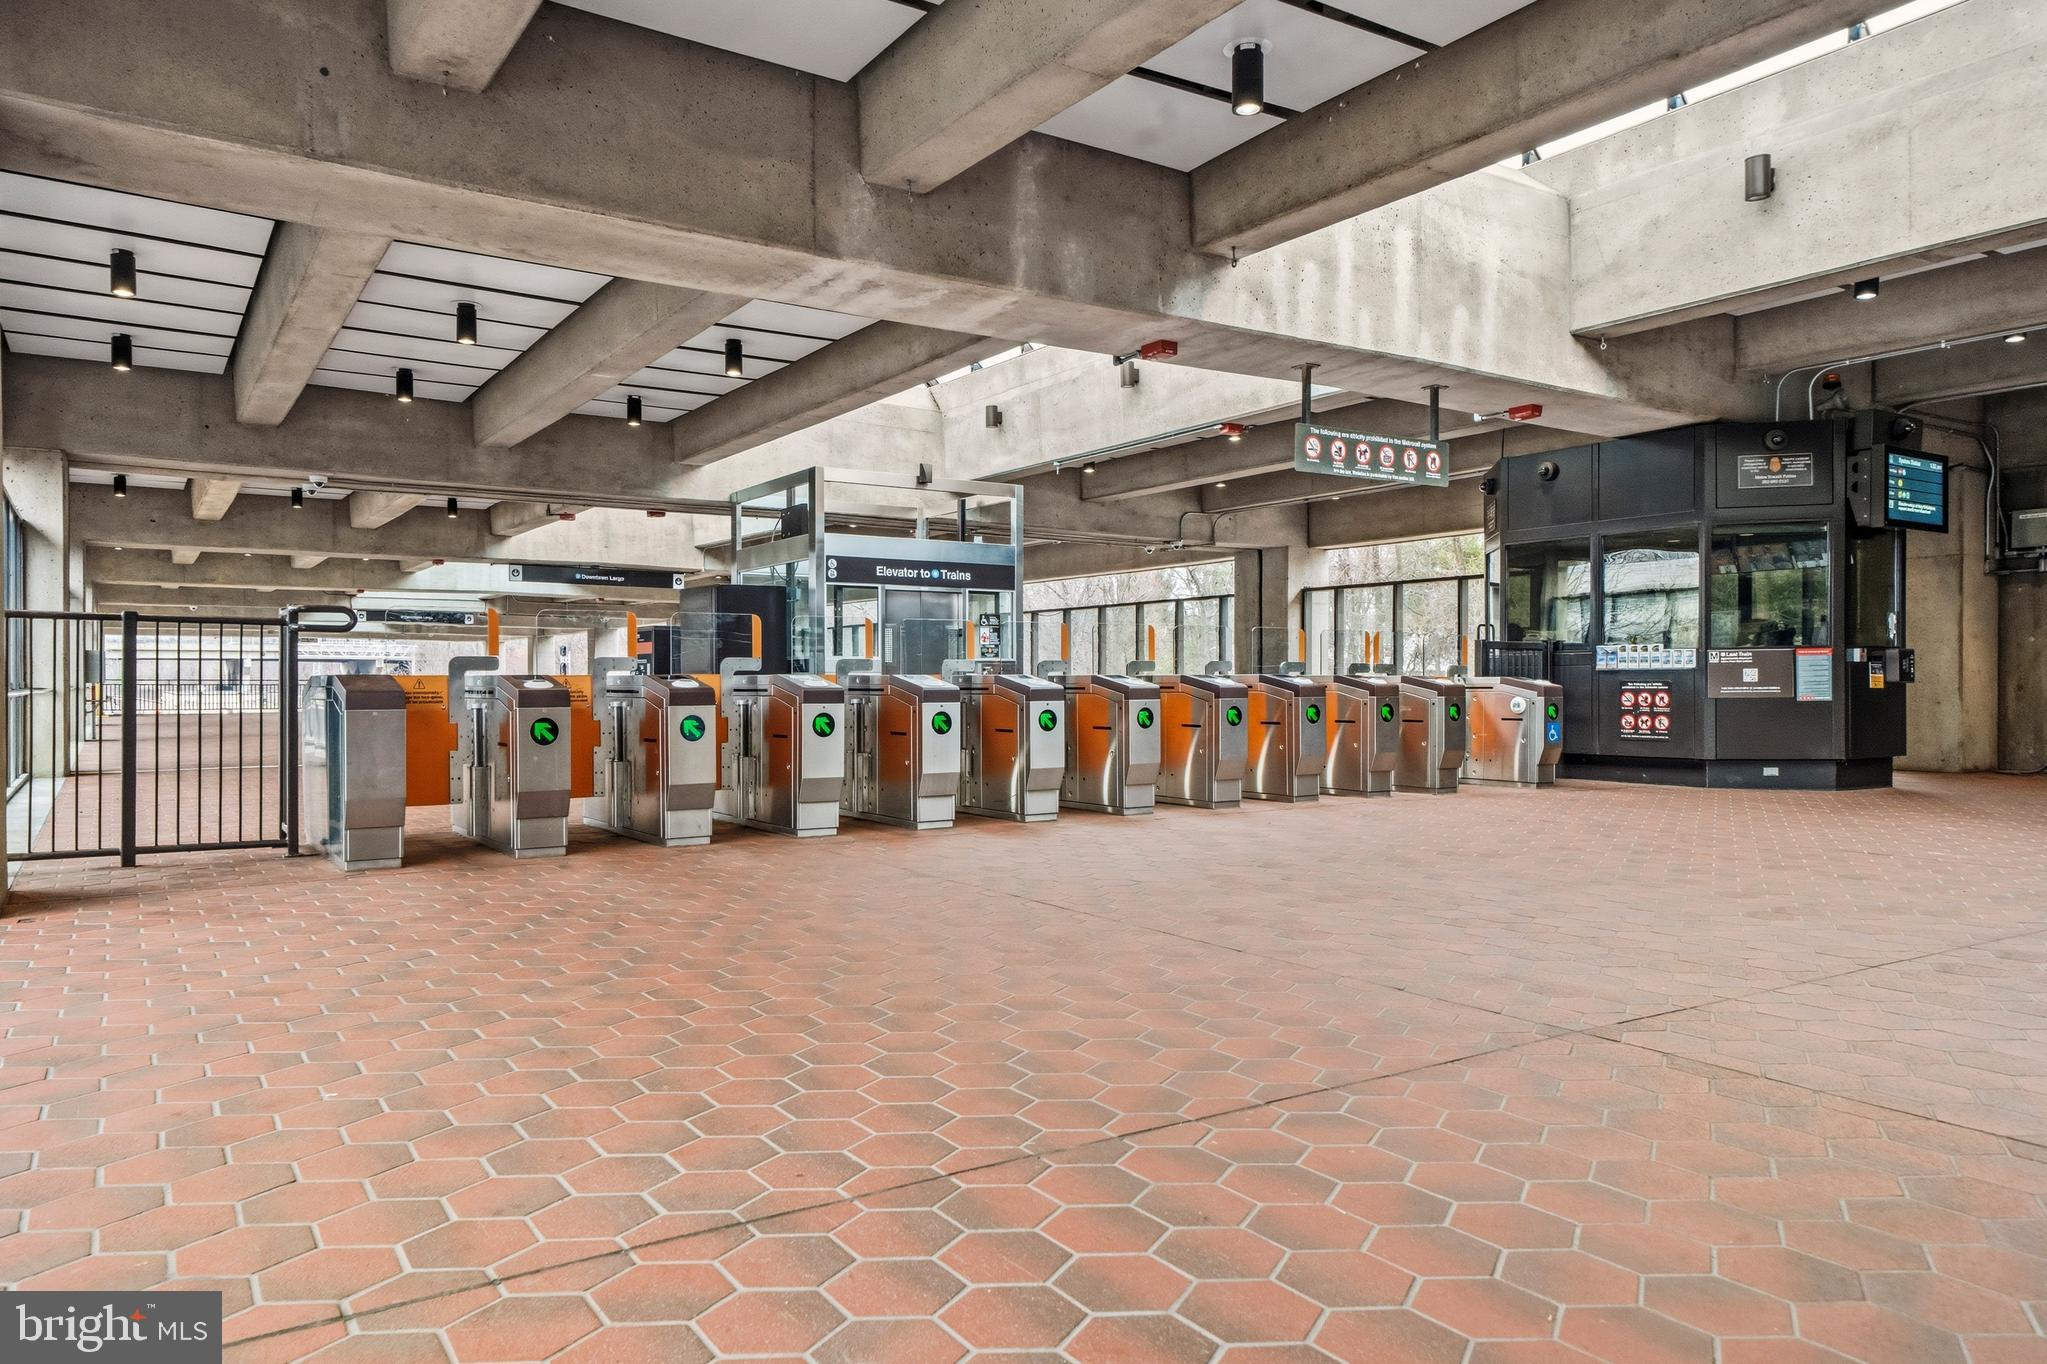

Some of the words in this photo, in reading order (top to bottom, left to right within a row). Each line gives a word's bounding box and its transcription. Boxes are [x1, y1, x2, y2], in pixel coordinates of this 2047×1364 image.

[876, 565, 918, 579] Elevator
[920, 568, 930, 579] to
[940, 569, 971, 581] Trains
